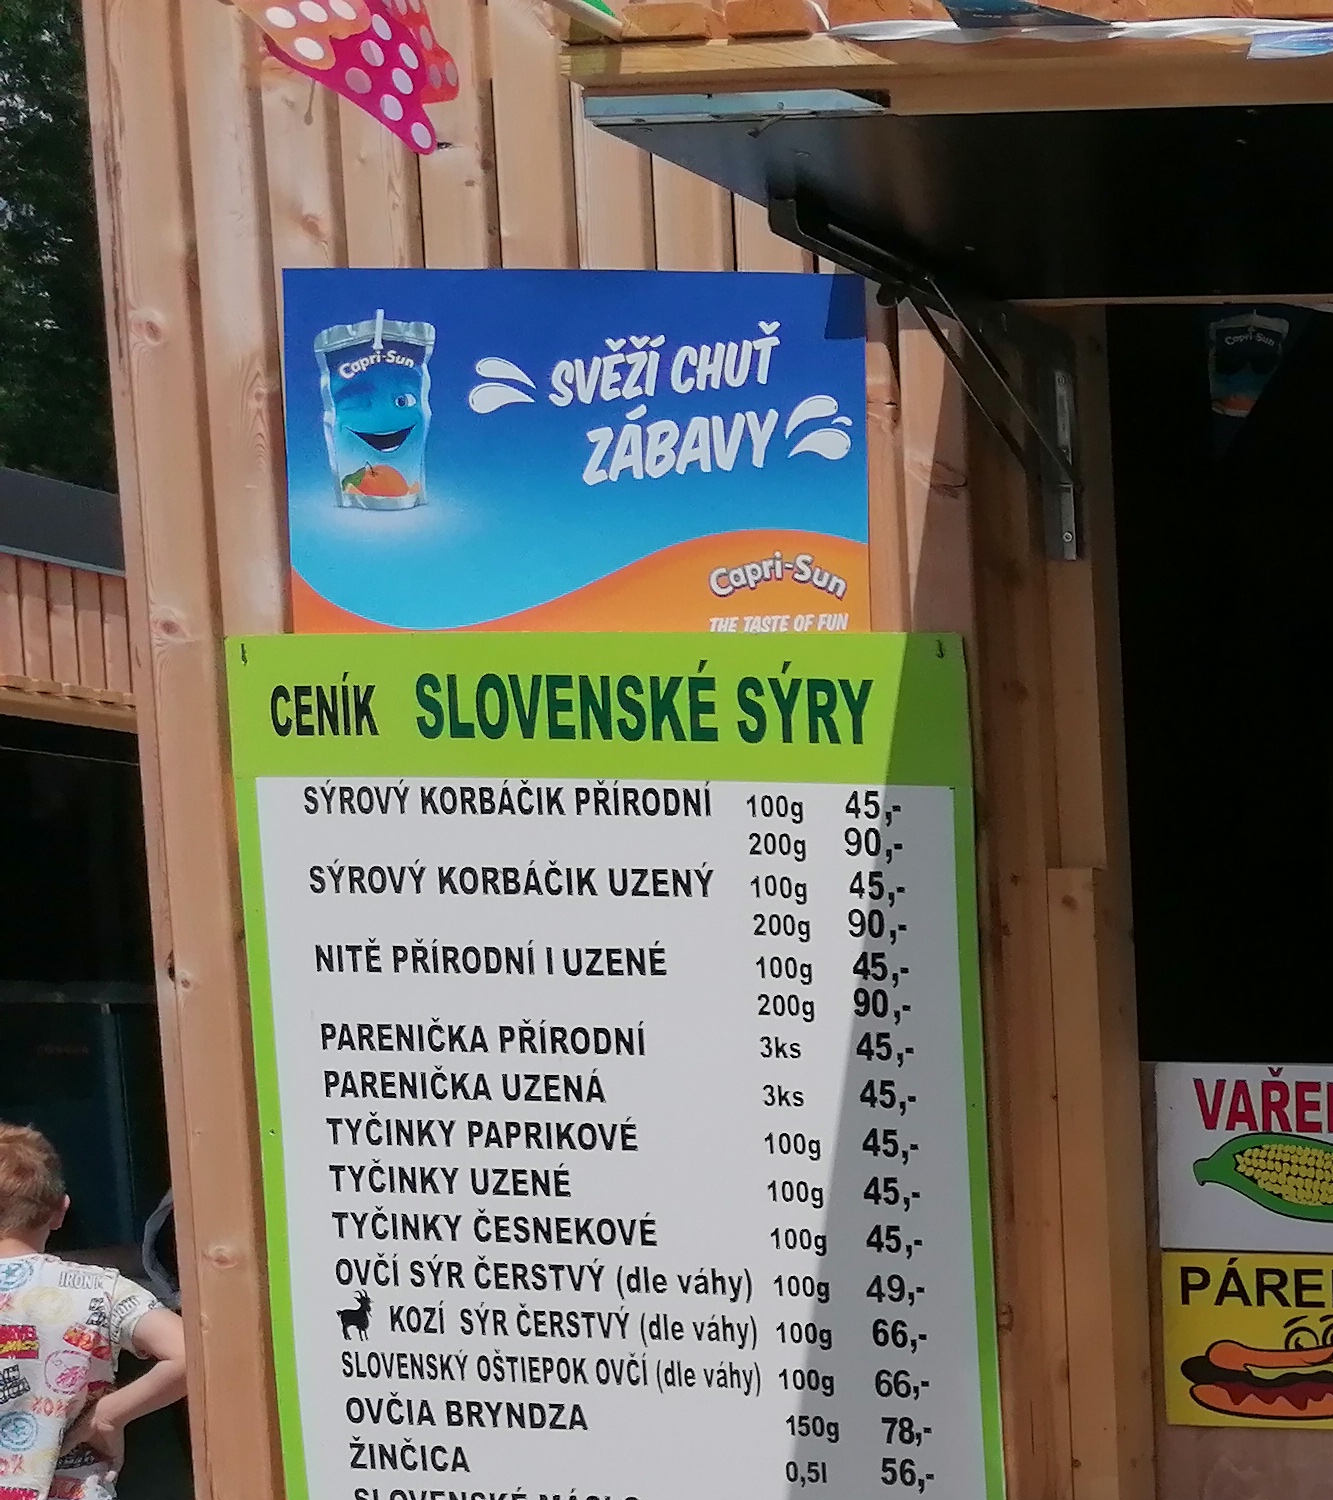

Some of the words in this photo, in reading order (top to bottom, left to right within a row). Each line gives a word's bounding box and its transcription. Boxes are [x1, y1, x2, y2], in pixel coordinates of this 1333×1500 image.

[337, 348, 415, 380] Capri-Sun
[548, 334, 661, 410] SVĚŽÍ
[670, 321, 781, 395] CHUŤ
[582, 405, 780, 488] ZÁBAVY
[708, 552, 848, 602] Capri-Sun
[709, 616, 739, 633] THE
[743, 614, 790, 633] TASTE
[793, 613, 815, 632] OF
[817, 611, 848, 632] FUN
[270, 672, 379, 738] CENÍK
[415, 659, 719, 744] SLOVENSKÉ
[736, 661, 875, 745] SÝRY
[303, 780, 409, 815] SÝROVÝ
[420, 780, 566, 816] KORBÁČIK
[574, 780, 712, 817] PŘÍRODNÍ
[747, 795, 804, 824] 100g
[845, 790, 901, 827] 45,-
[749, 833, 807, 862] 200g
[844, 827, 903, 864] 90,-
[309, 859, 426, 895] SÝROVÝ
[438, 860, 598, 896] KORBÁČIK
[608, 862, 714, 898] UZENÝ
[750, 875, 807, 905] 100g
[849, 870, 906, 908] 45,-
[753, 913, 811, 943] 200g
[848, 908, 907, 946] 90,-
[315, 937, 382, 972] NITĚ
[393, 938, 535, 976] PŘÍRODNÍ
[546, 947, 554, 974] I
[563, 940, 667, 977] UZENÉ
[756, 956, 813, 985] 100g
[852, 951, 909, 988] 45,-
[758, 994, 815, 1023] 200g
[853, 988, 911, 1026] 90,-
[320, 1017, 489, 1052] PARENIČKA
[499, 1018, 646, 1056] PŘÍRODNÍ
[759, 1036, 802, 1059] 3ks
[856, 1031, 915, 1069] 45,-
[324, 1065, 493, 1101] PARENIČKA
[501, 1067, 607, 1103] UZENÁ
[762, 1084, 804, 1107] 3ks
[859, 1079, 917, 1117] 45,-
[325, 1111, 456, 1147] TYČINKY
[467, 1116, 639, 1152] PAPRIKOVÉ
[764, 1132, 821, 1162] 100g
[862, 1128, 919, 1164] 45,-
[329, 1158, 459, 1195] TYČINKY
[470, 1163, 571, 1198] UZENÉ
[767, 1180, 824, 1209] 100g
[863, 1176, 921, 1212] 45,-
[331, 1206, 462, 1242] TYČINKY
[473, 1208, 658, 1247] ČESNEKOVÉ
[770, 1228, 828, 1256] 100g
[866, 1224, 923, 1260] 45,-
[335, 1252, 400, 1287] OVČÍ
[410, 1255, 465, 1289] SÝR
[473, 1255, 604, 1293] ČERSTVÝ
[616, 1265, 667, 1301] (dle
[678, 1266, 754, 1303] váhy)
[773, 1275, 830, 1304] 100g
[866, 1273, 925, 1307] 49,-
[390, 1300, 445, 1335] KOZÍ
[460, 1303, 507, 1337] SÝR
[516, 1303, 630, 1340] ČERSTVÝ
[640, 1313, 684, 1347] (dle
[693, 1314, 758, 1350] váhy)
[776, 1322, 833, 1350] 100g
[872, 1318, 927, 1353] 66,-
[341, 1348, 468, 1382] SLOVENSKÝ
[476, 1349, 588, 1385] OŠTIEPOK
[596, 1352, 649, 1387] OVČÍ
[656, 1360, 696, 1394] (dle
[704, 1360, 762, 1398] váhy)
[778, 1369, 835, 1397] 100g
[874, 1369, 930, 1400] 66,-
[345, 1391, 436, 1427] OVČIA
[445, 1399, 589, 1431] BRYNDZA
[785, 1415, 840, 1444] 150g
[880, 1416, 932, 1447] 78,-
[349, 1435, 471, 1473] ŽINČICA
[880, 1457, 935, 1494] 56,-
